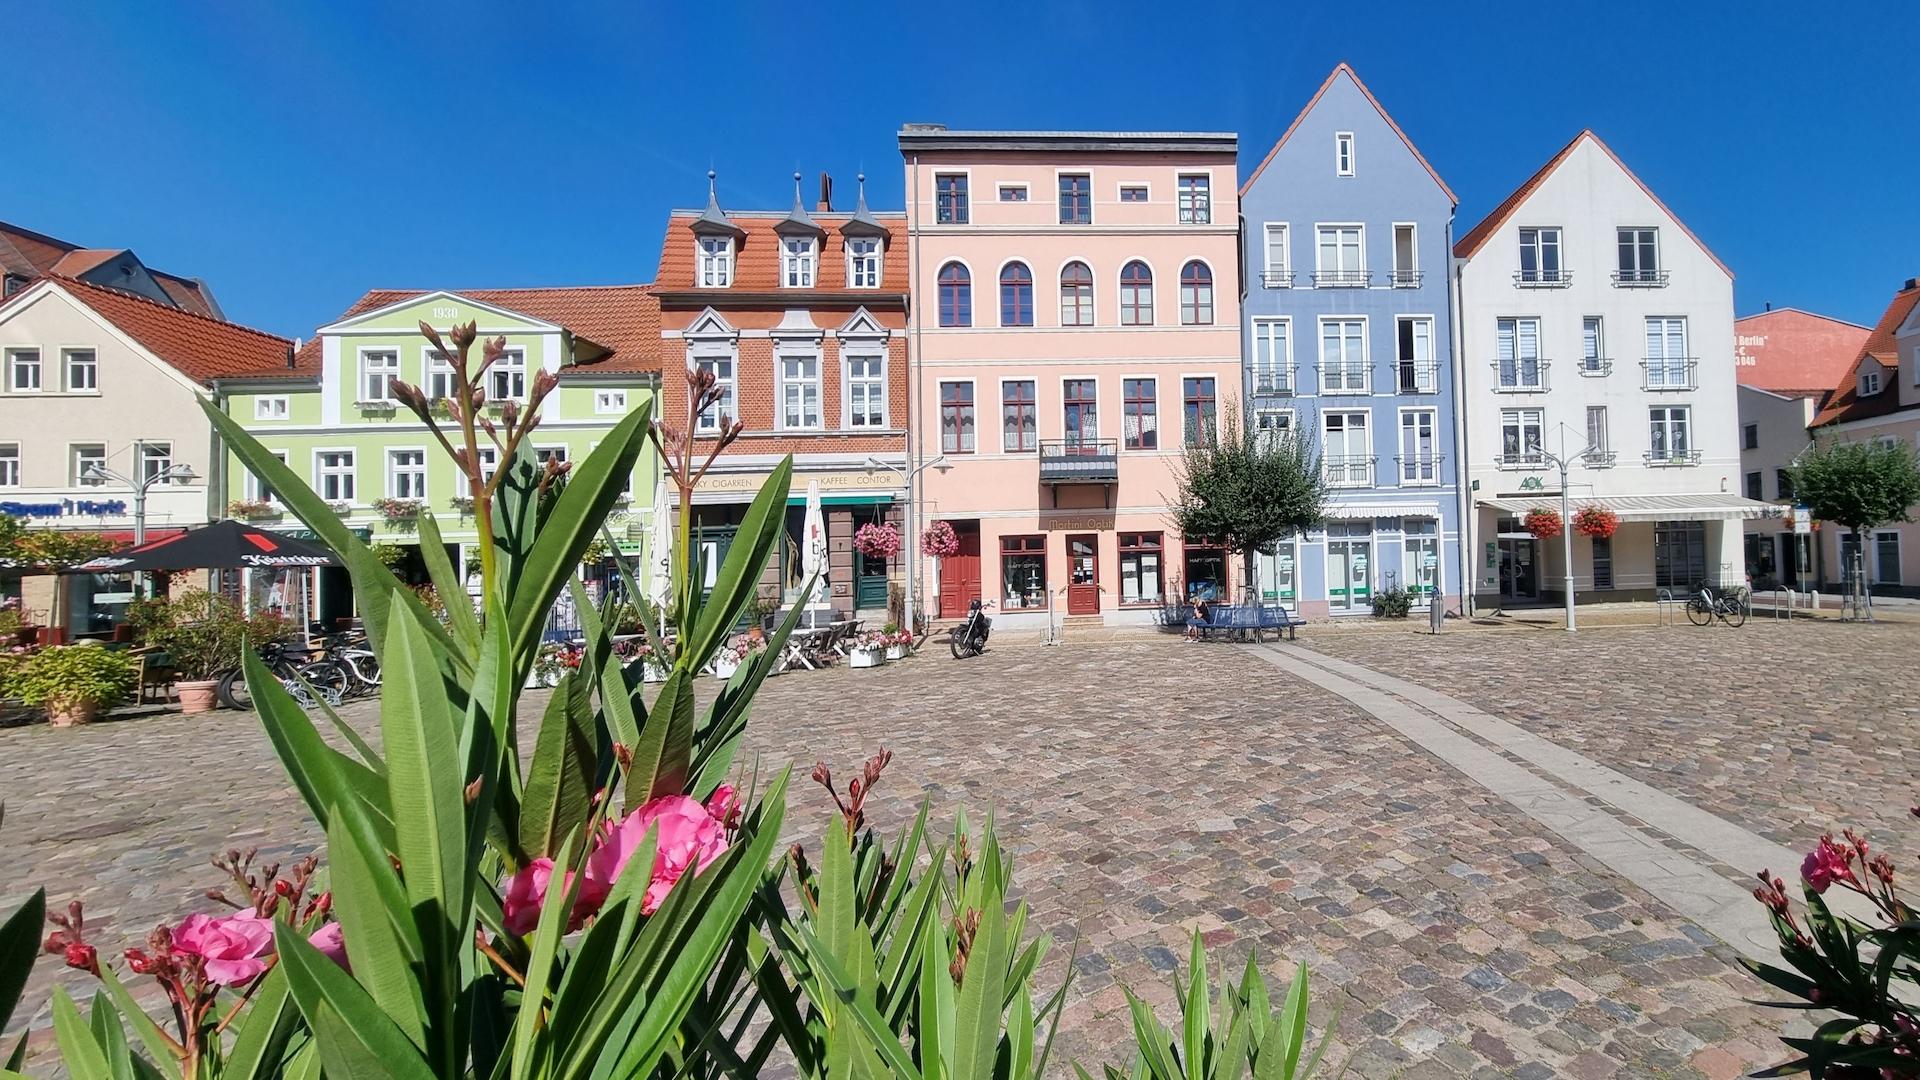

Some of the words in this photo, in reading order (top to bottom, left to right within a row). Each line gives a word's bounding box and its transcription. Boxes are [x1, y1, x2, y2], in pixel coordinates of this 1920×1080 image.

[433, 307, 458, 318] 1930
[712, 479, 752, 488] CIGARREN
[820, 476, 848, 485] KAFFEE
[856, 475, 891, 485] CONTOR
[1518, 476, 1545, 490] AOK
[1048, 519, 1082, 531] Martini
